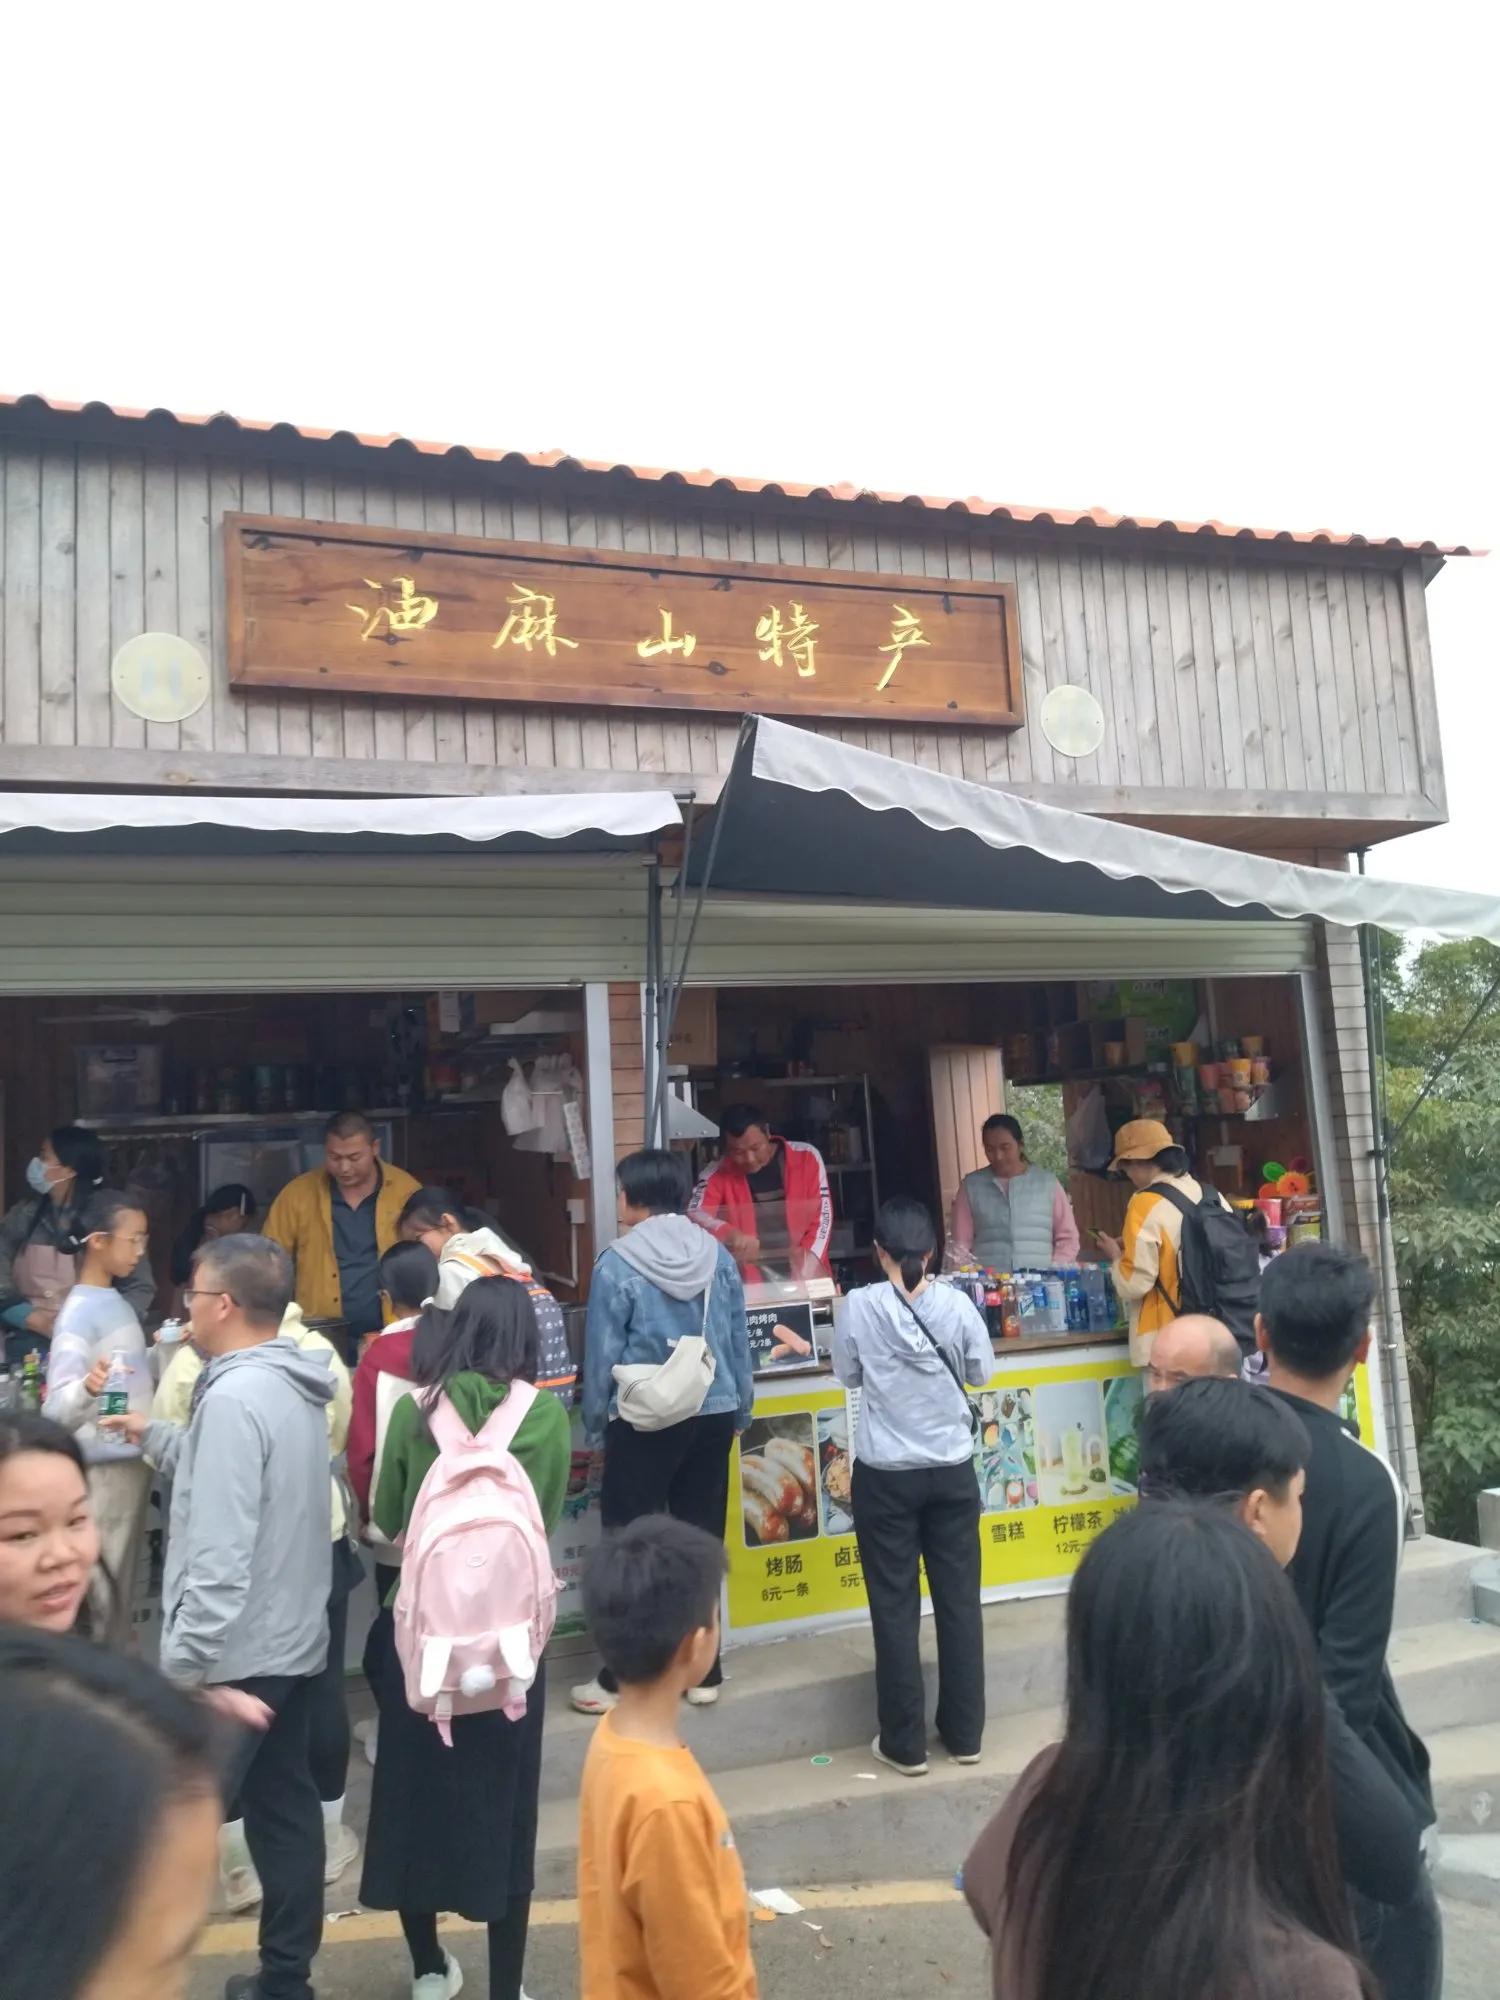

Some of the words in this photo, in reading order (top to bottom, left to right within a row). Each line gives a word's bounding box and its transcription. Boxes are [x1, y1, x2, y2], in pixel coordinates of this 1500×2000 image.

[345, 577, 931, 691] 油麻山特产
[746, 1312, 778, 1326] 肉烤肉
[750, 1338, 772, 1348] 元/2条
[991, 1521, 1025, 1544] 雪糕
[1053, 1510, 1104, 1535] 柠檬茶
[835, 1546, 861, 1567] 卤豆
[1056, 1540, 1091, 1554] 12元一
[766, 1554, 803, 1577] 烤肠
